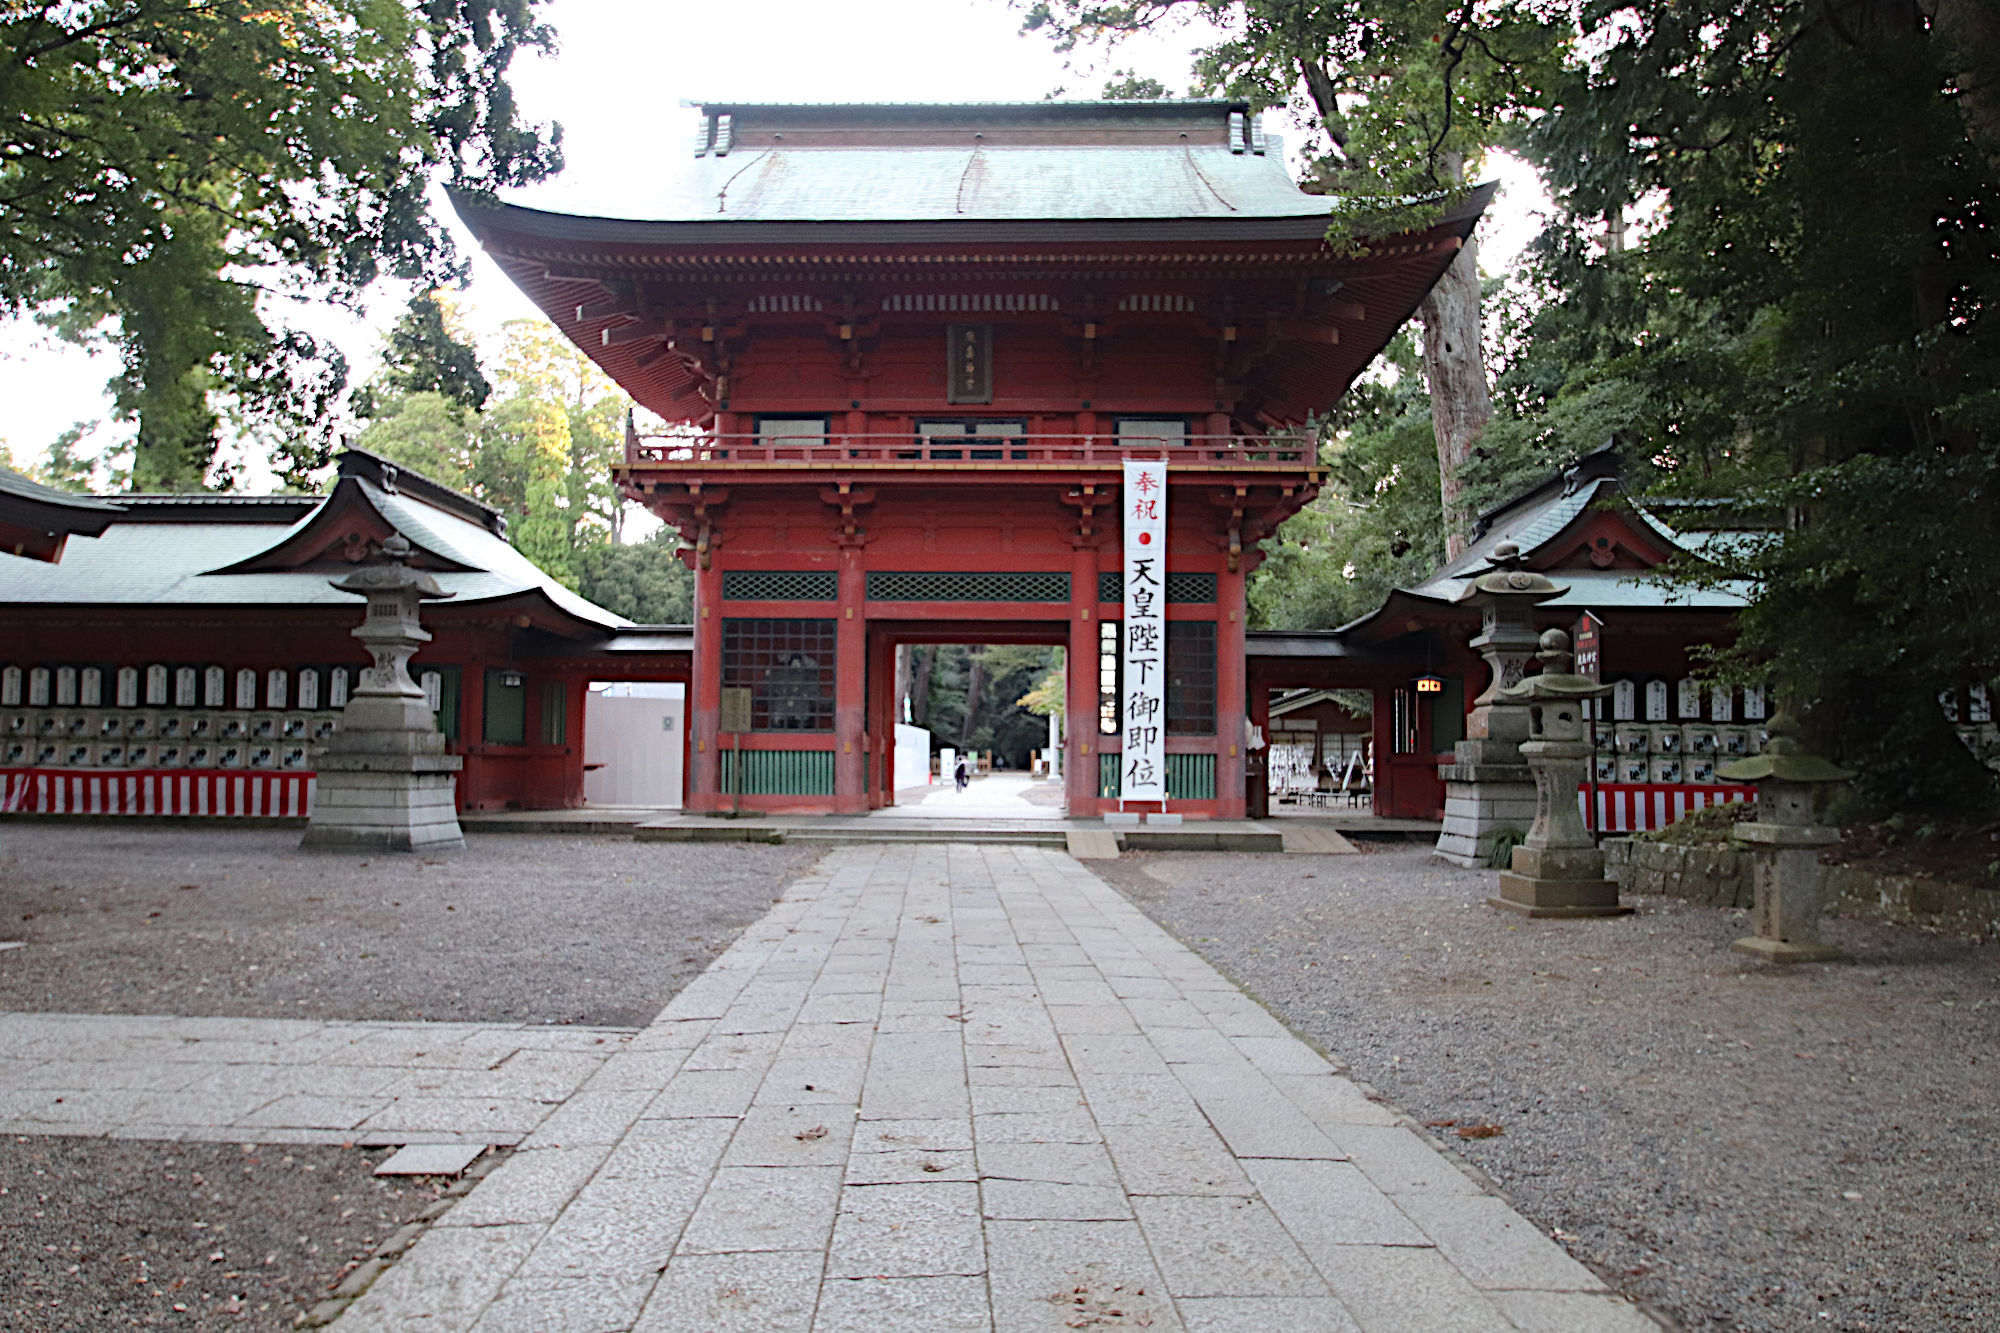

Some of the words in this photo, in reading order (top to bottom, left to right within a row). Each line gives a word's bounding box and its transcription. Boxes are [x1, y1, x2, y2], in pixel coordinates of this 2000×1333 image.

[1131, 471, 1159, 520] 奉祝
[1126, 558, 1160, 788] 天皇陛下御即位
